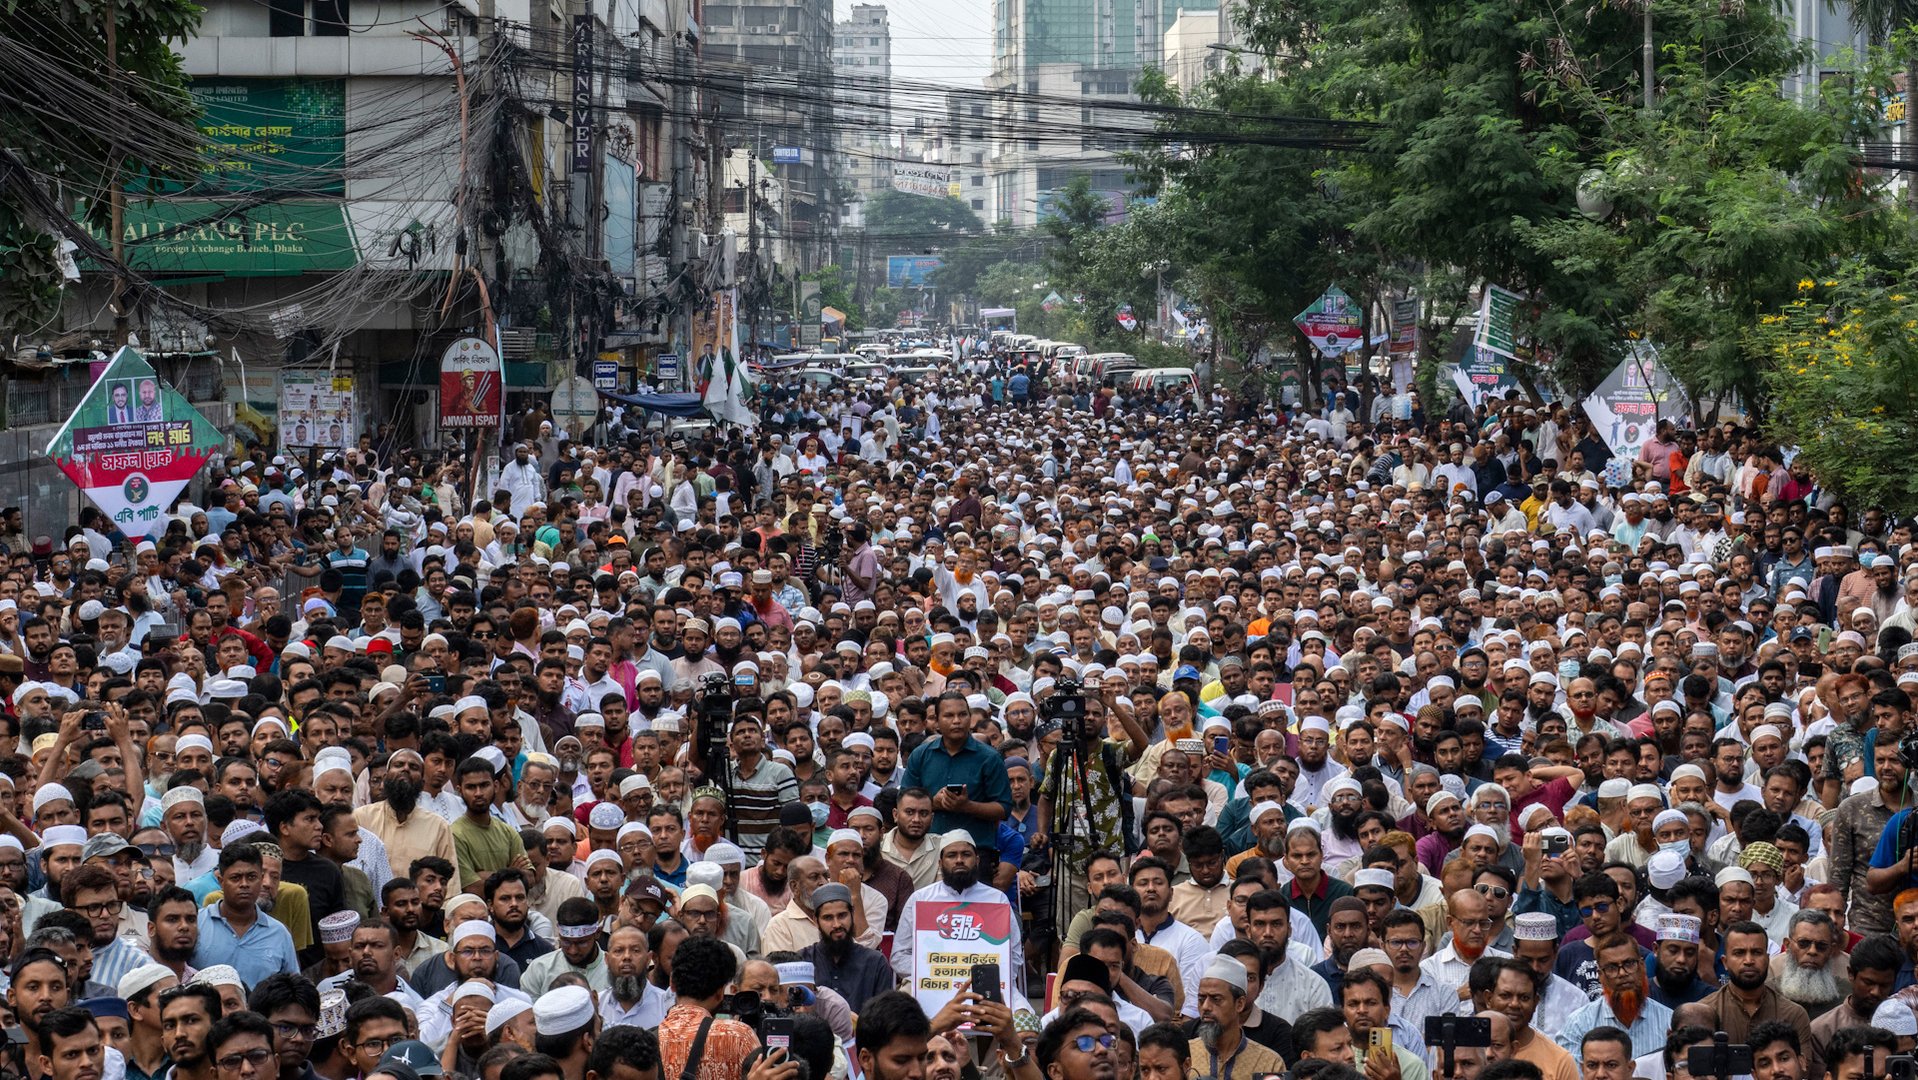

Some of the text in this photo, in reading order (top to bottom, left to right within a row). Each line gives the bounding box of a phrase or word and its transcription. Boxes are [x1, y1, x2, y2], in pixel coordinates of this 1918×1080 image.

[254, 222, 308, 241] PLC.
[155, 244, 190, 255] Foreign
[191, 244, 235, 255] Exchange
[273, 244, 304, 253] Dhaka
[442, 414, 499, 427] ANWAR ISPAT
[148, 424, 191, 446] লং মার্চ
[102, 450, 173, 470] সফল হোক
[115, 504, 161, 524] এবি পার্টি
[930, 953, 958, 965] বিচার
[935, 967, 972, 977] হত্যাকা
[921, 978, 950, 991] বিচার
